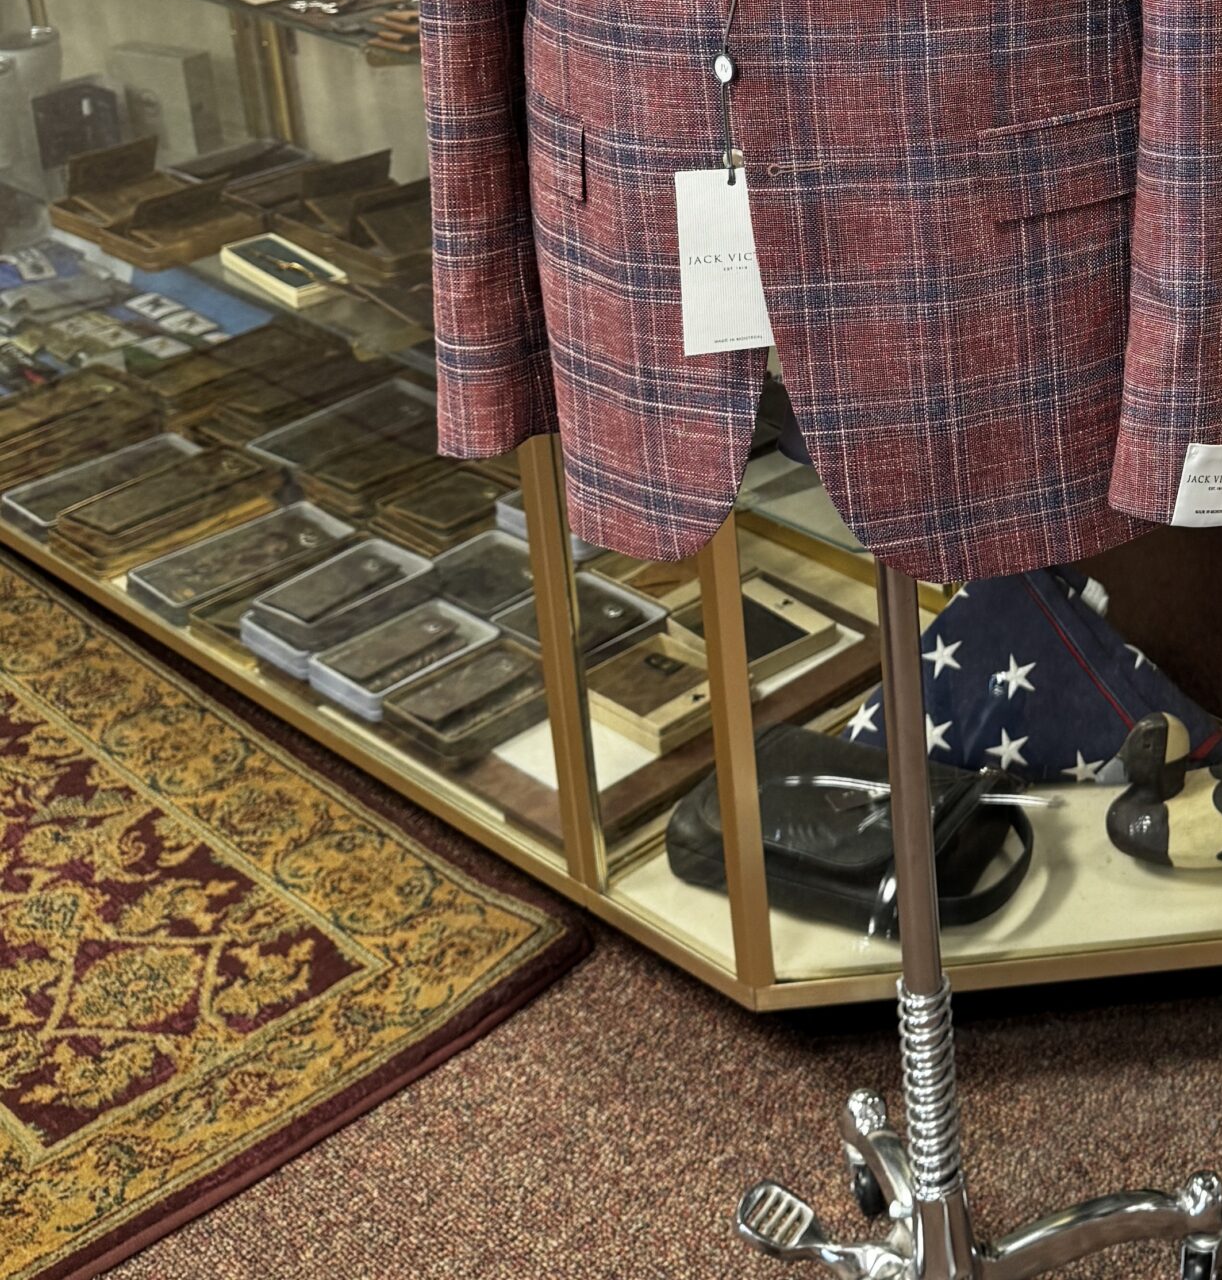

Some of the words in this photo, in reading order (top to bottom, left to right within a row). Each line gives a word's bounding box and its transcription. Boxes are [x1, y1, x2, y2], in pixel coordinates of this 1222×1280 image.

[688, 254, 723, 266] JACK
[728, 251, 755, 263] VIC
[1187, 474, 1211, 484] JACK
